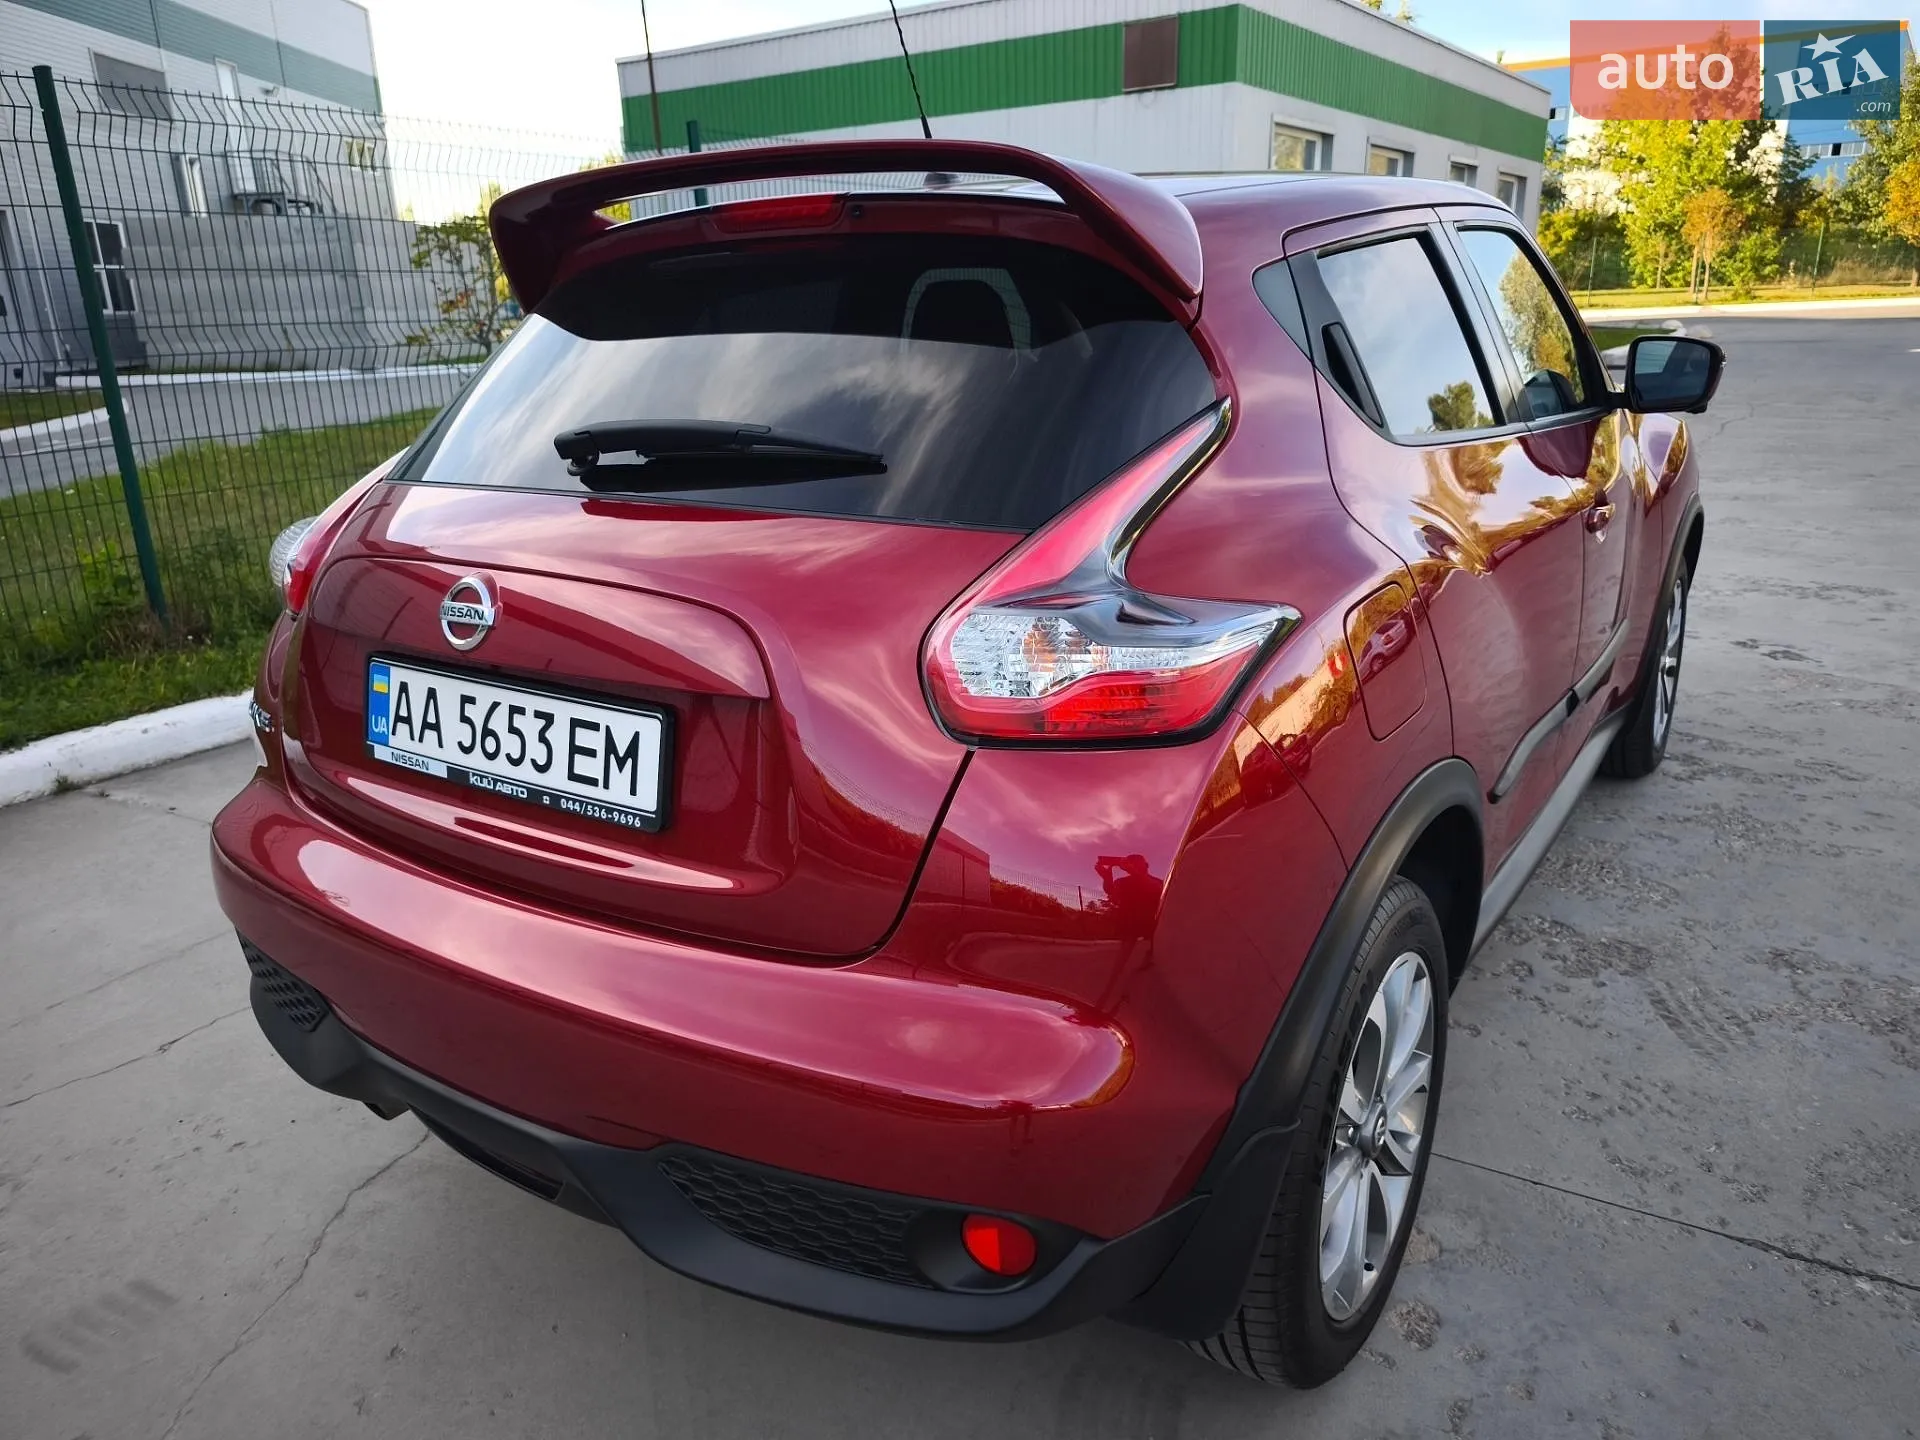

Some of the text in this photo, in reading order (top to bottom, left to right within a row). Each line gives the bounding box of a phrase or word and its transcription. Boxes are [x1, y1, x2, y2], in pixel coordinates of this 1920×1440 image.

[442, 604, 485, 621] NISSAN
[371, 714, 388, 736] UA
[391, 680, 641, 797] AA 5653 EM
[391, 751, 430, 771] NISSAN
[560, 798, 642, 828] 044/536-9696
